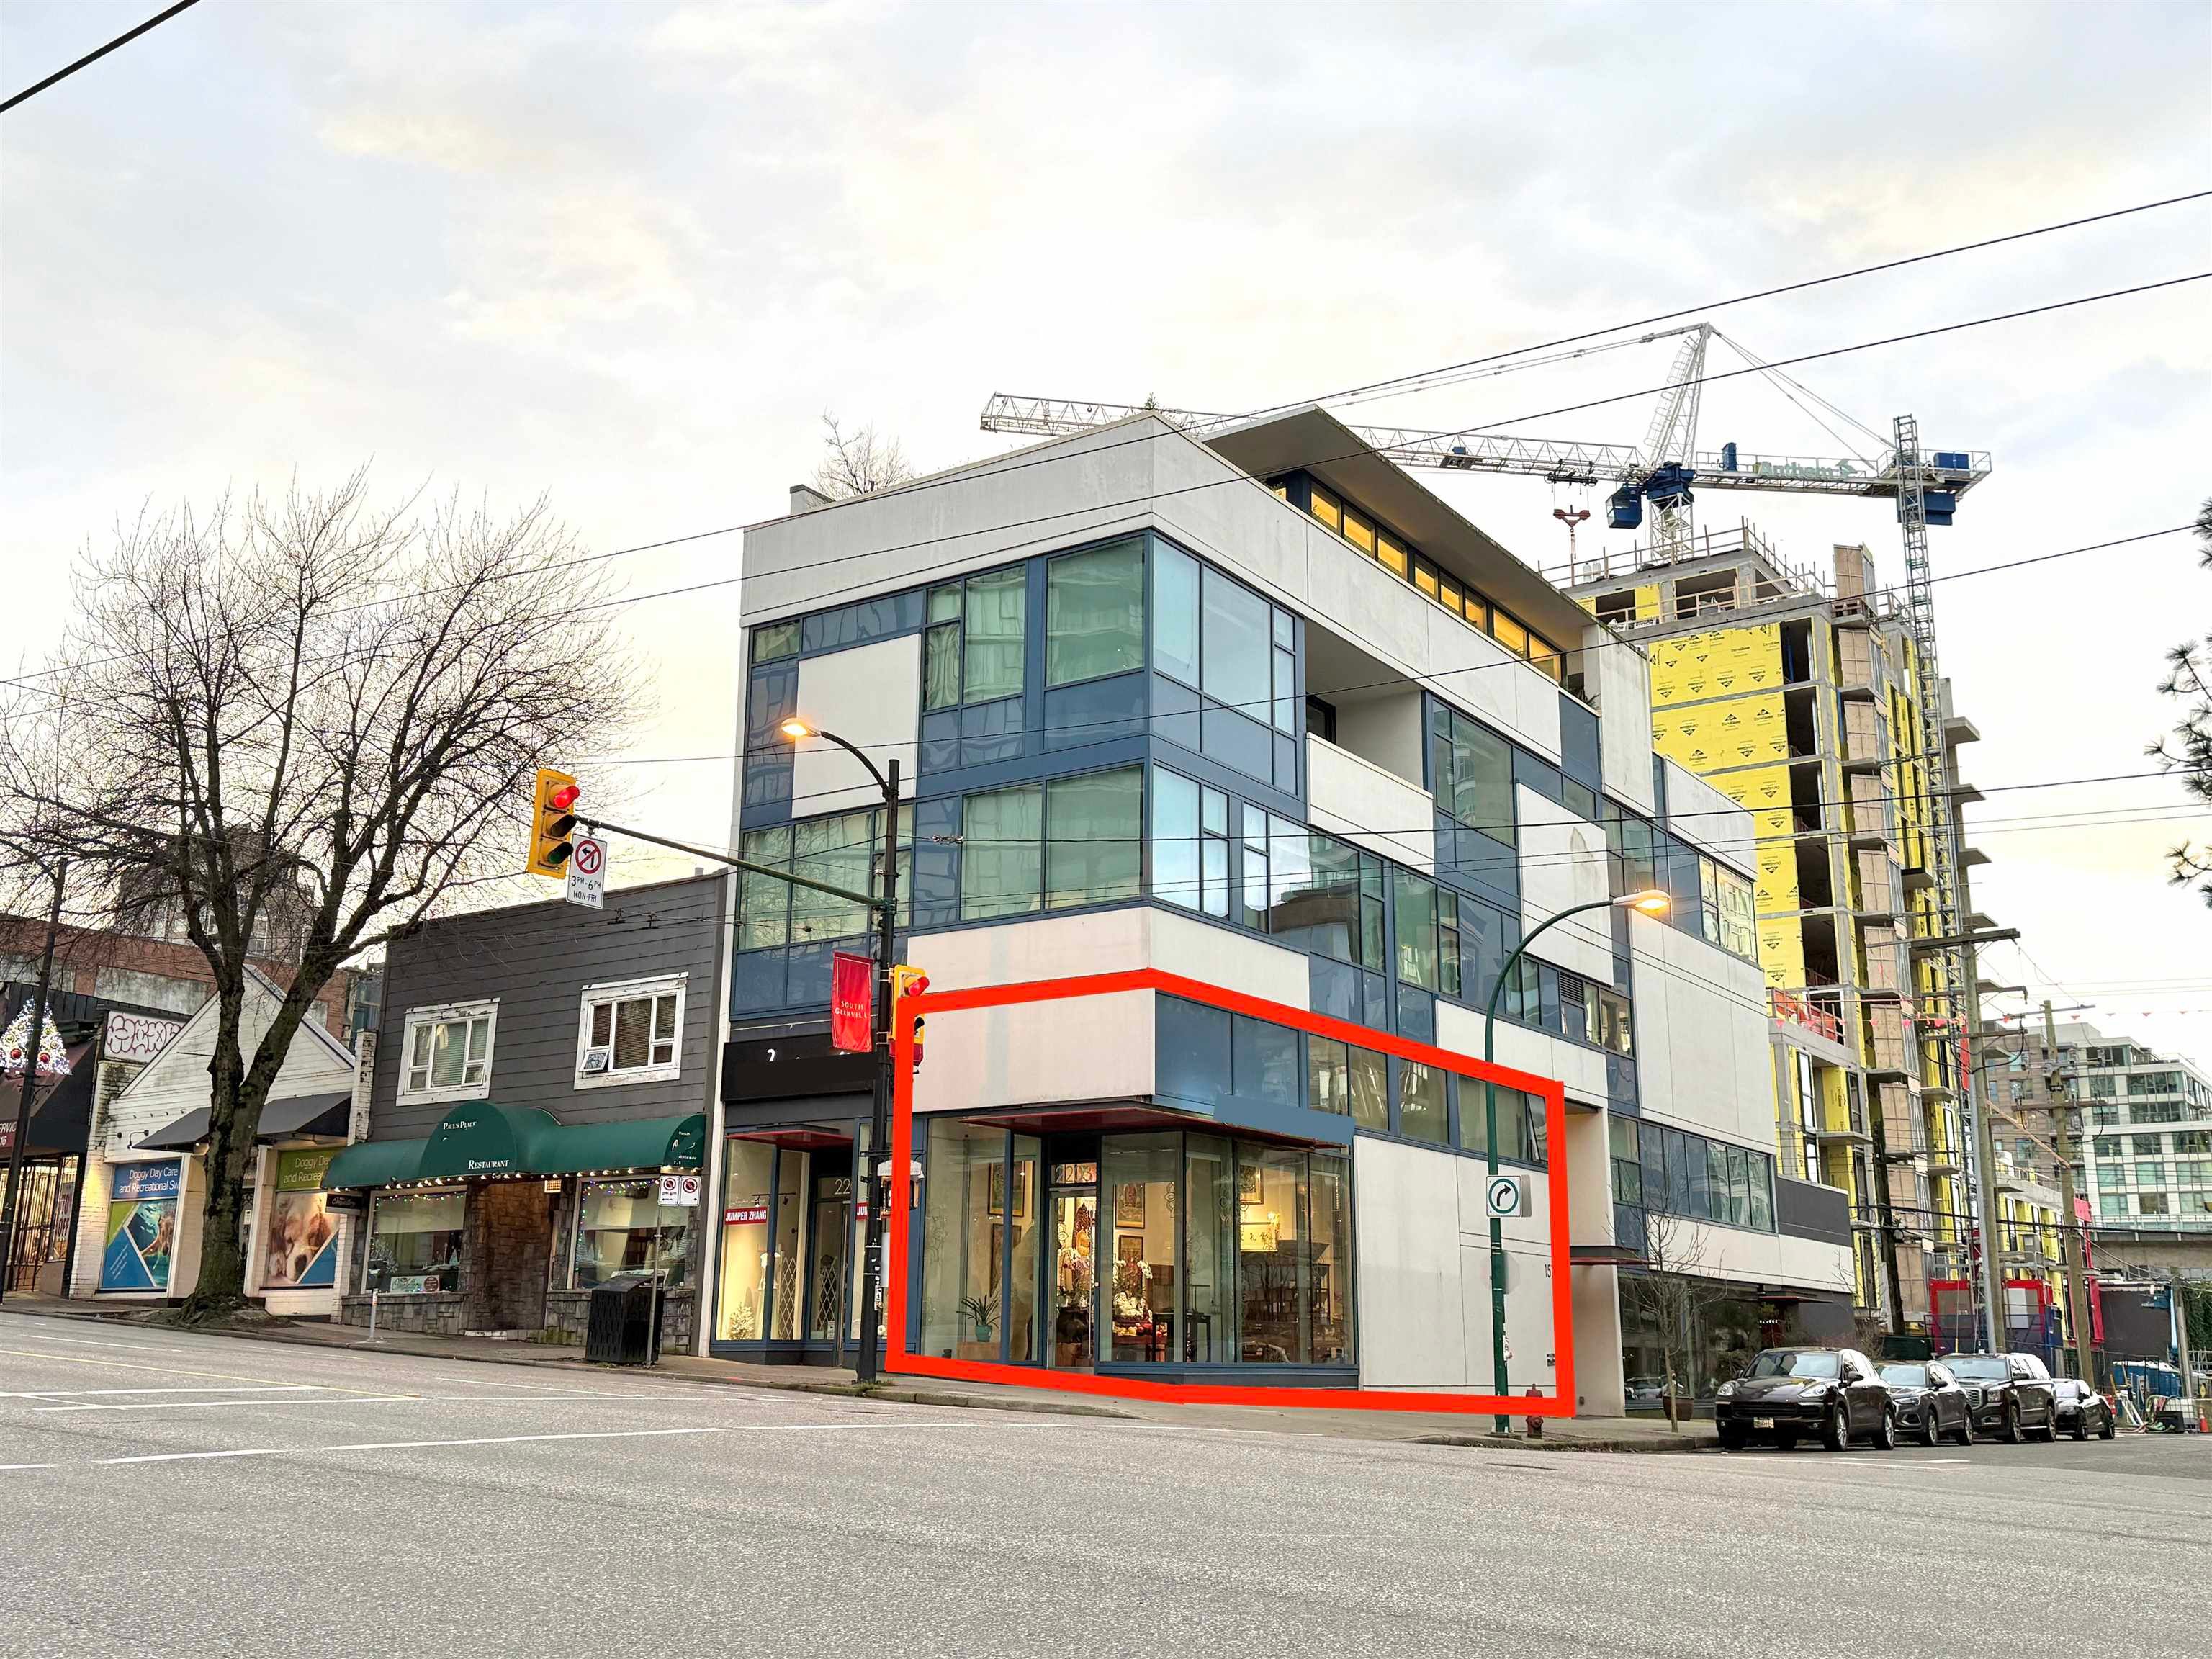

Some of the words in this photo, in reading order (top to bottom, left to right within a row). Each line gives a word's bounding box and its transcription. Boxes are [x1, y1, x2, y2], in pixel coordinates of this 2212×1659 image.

[1762, 461, 1840, 480] Anthem
[295, 1158, 317, 1170] Doggy
[318, 1155, 331, 1166] Da
[468, 1159, 510, 1169] RESTAURANT
[130, 1169, 149, 1181] Doggy
[150, 1168, 163, 1179] Day
[163, 1166, 178, 1177] Care
[283, 1172, 297, 1184] and
[119, 1183, 131, 1193] and
[132, 1181, 168, 1192] Recreational
[835, 1178, 852, 1195] 22
[726, 1212, 747, 1222] JUMPER
[749, 1210, 767, 1220] ZHANG
